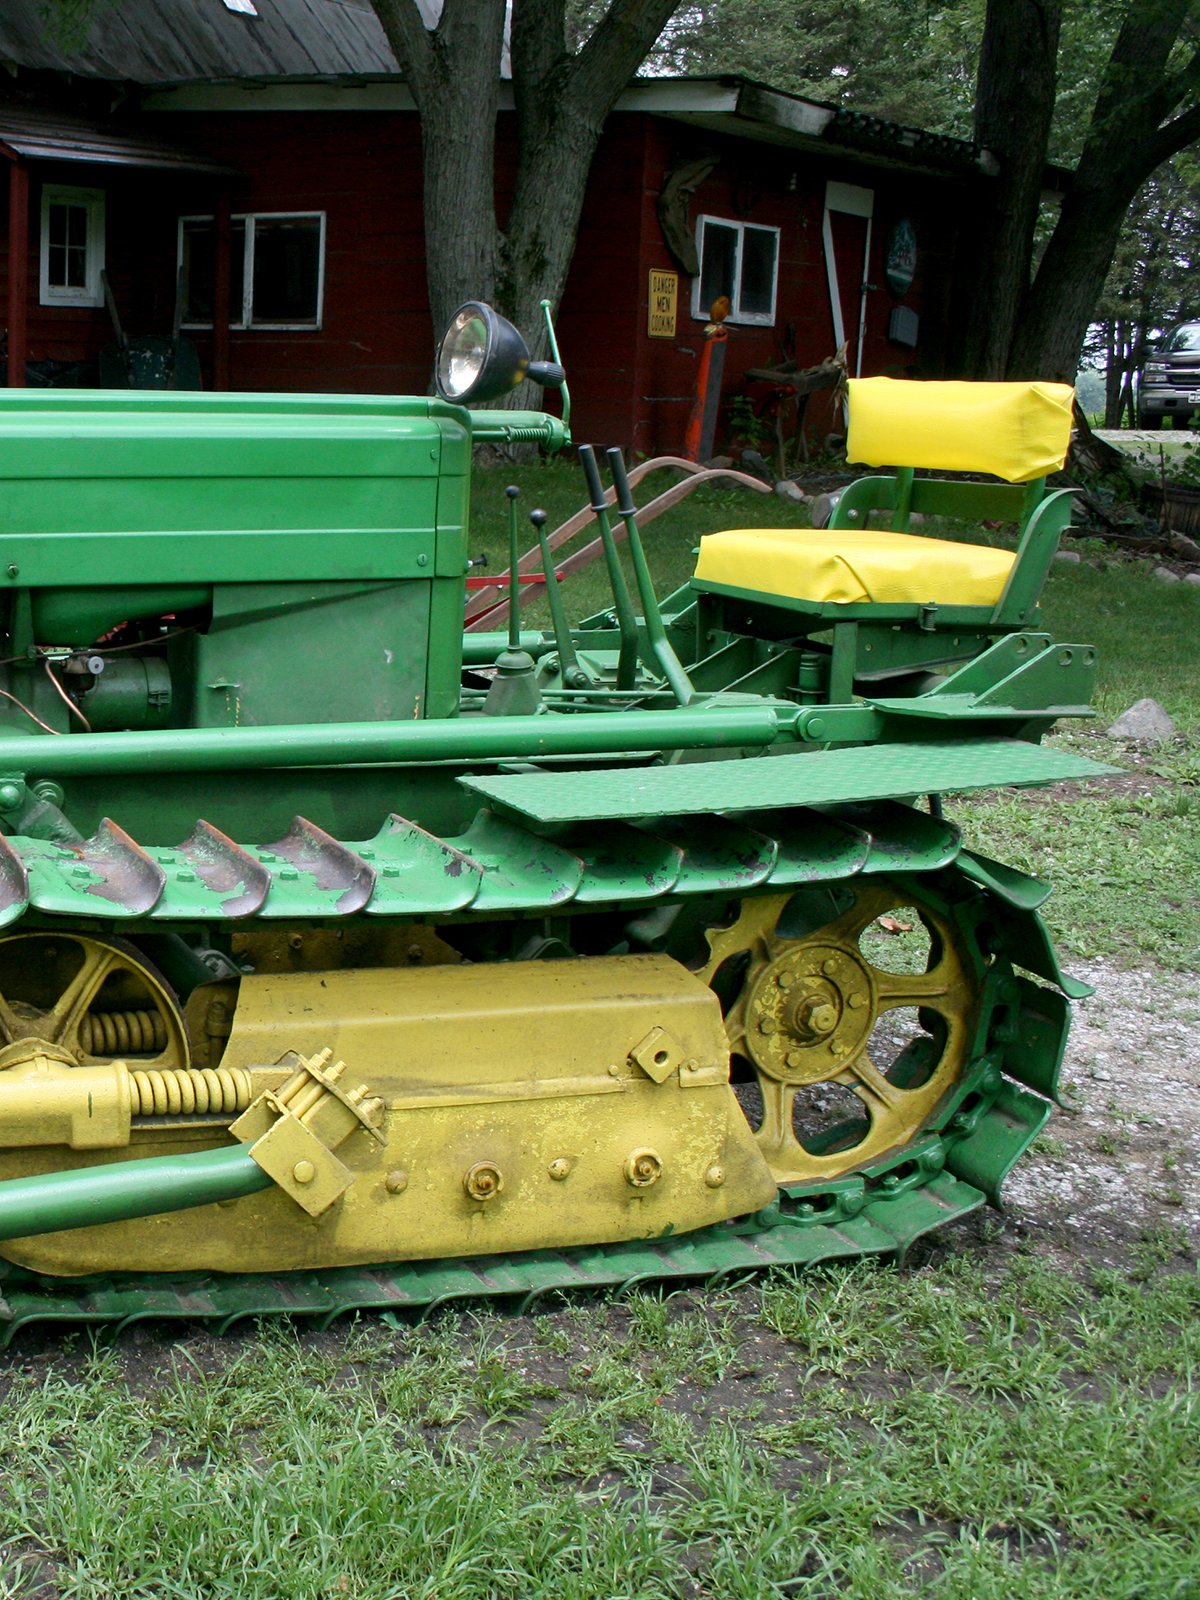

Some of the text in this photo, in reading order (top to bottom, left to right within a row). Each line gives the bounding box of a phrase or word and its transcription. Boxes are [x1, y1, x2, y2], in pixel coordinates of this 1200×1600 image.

[653, 276, 675, 294] DANGER
[656, 295, 671, 313] MEN
[651, 314, 674, 333] COOKING
